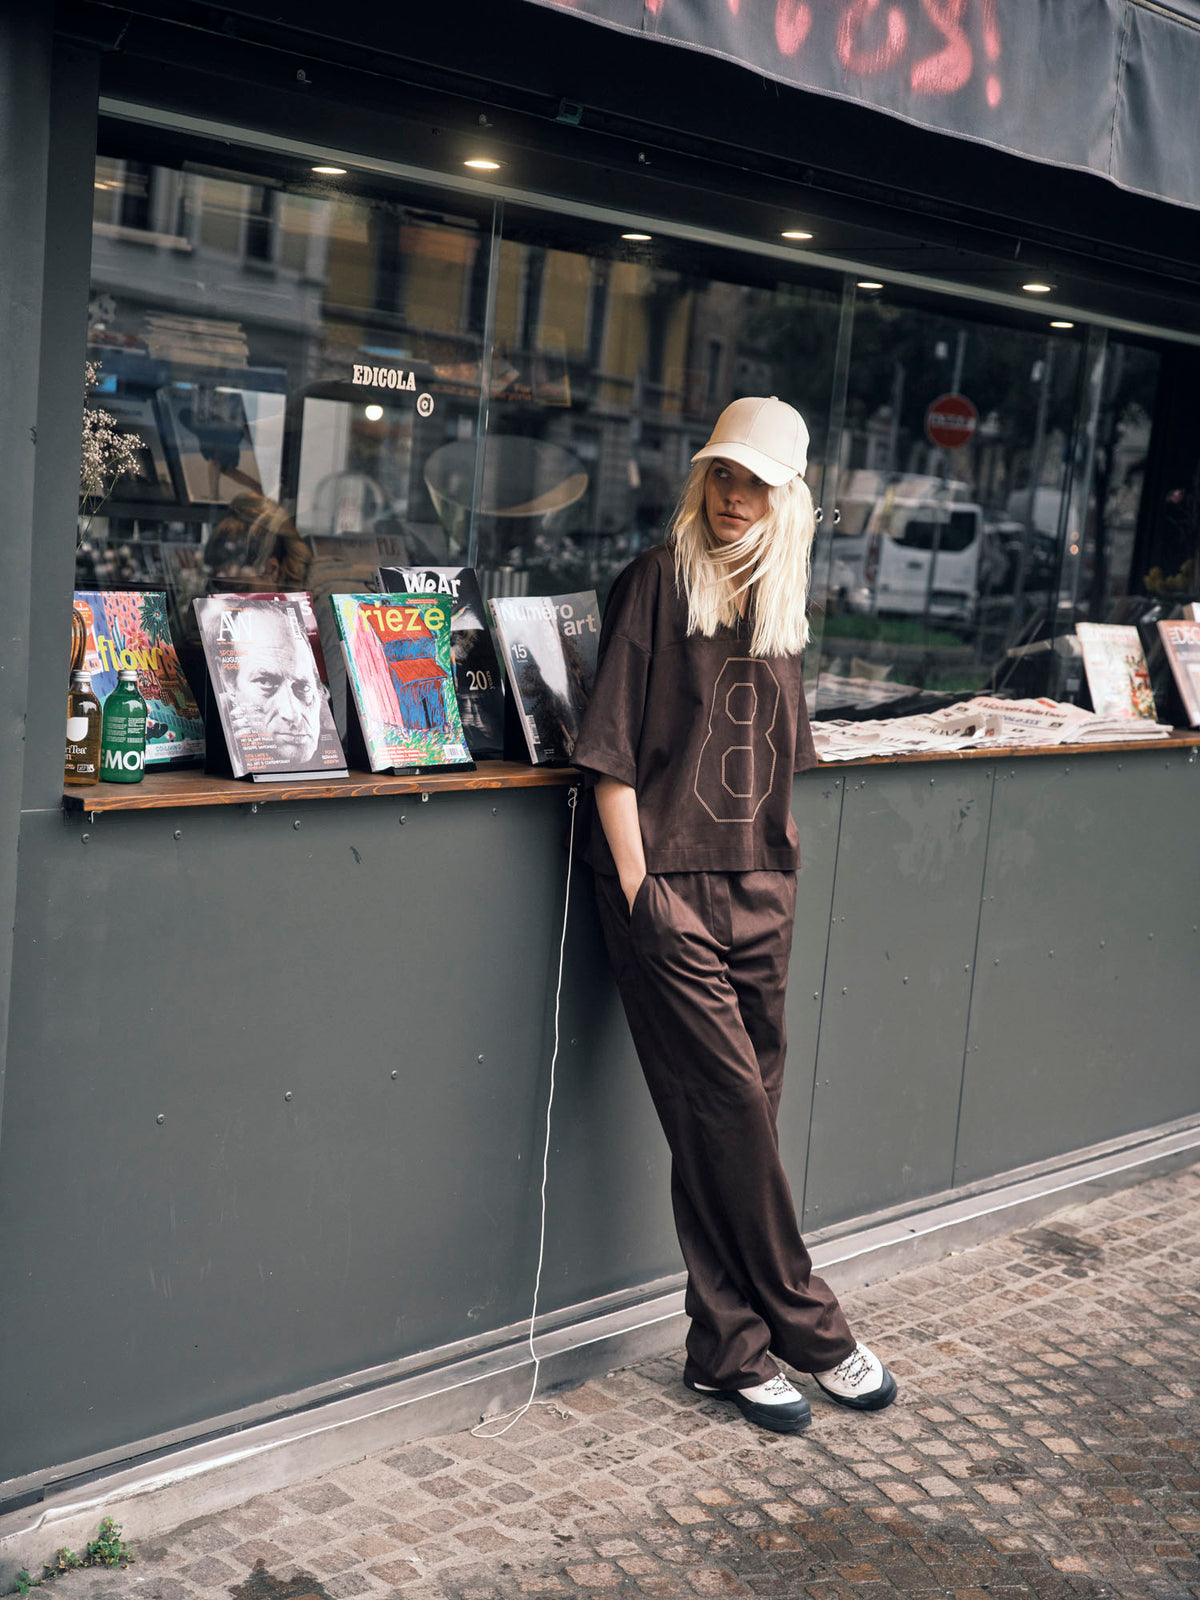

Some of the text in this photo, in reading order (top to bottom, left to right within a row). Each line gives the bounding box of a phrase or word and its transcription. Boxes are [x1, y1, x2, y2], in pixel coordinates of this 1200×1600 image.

[352, 364, 416, 391] EDICOLA
[403, 573, 461, 598] WeAr
[342, 601, 445, 632] frieze
[564, 614, 597, 637] art
[97, 635, 163, 671] flow
[512, 644, 528, 659] 15
[466, 670, 488, 691] 20
